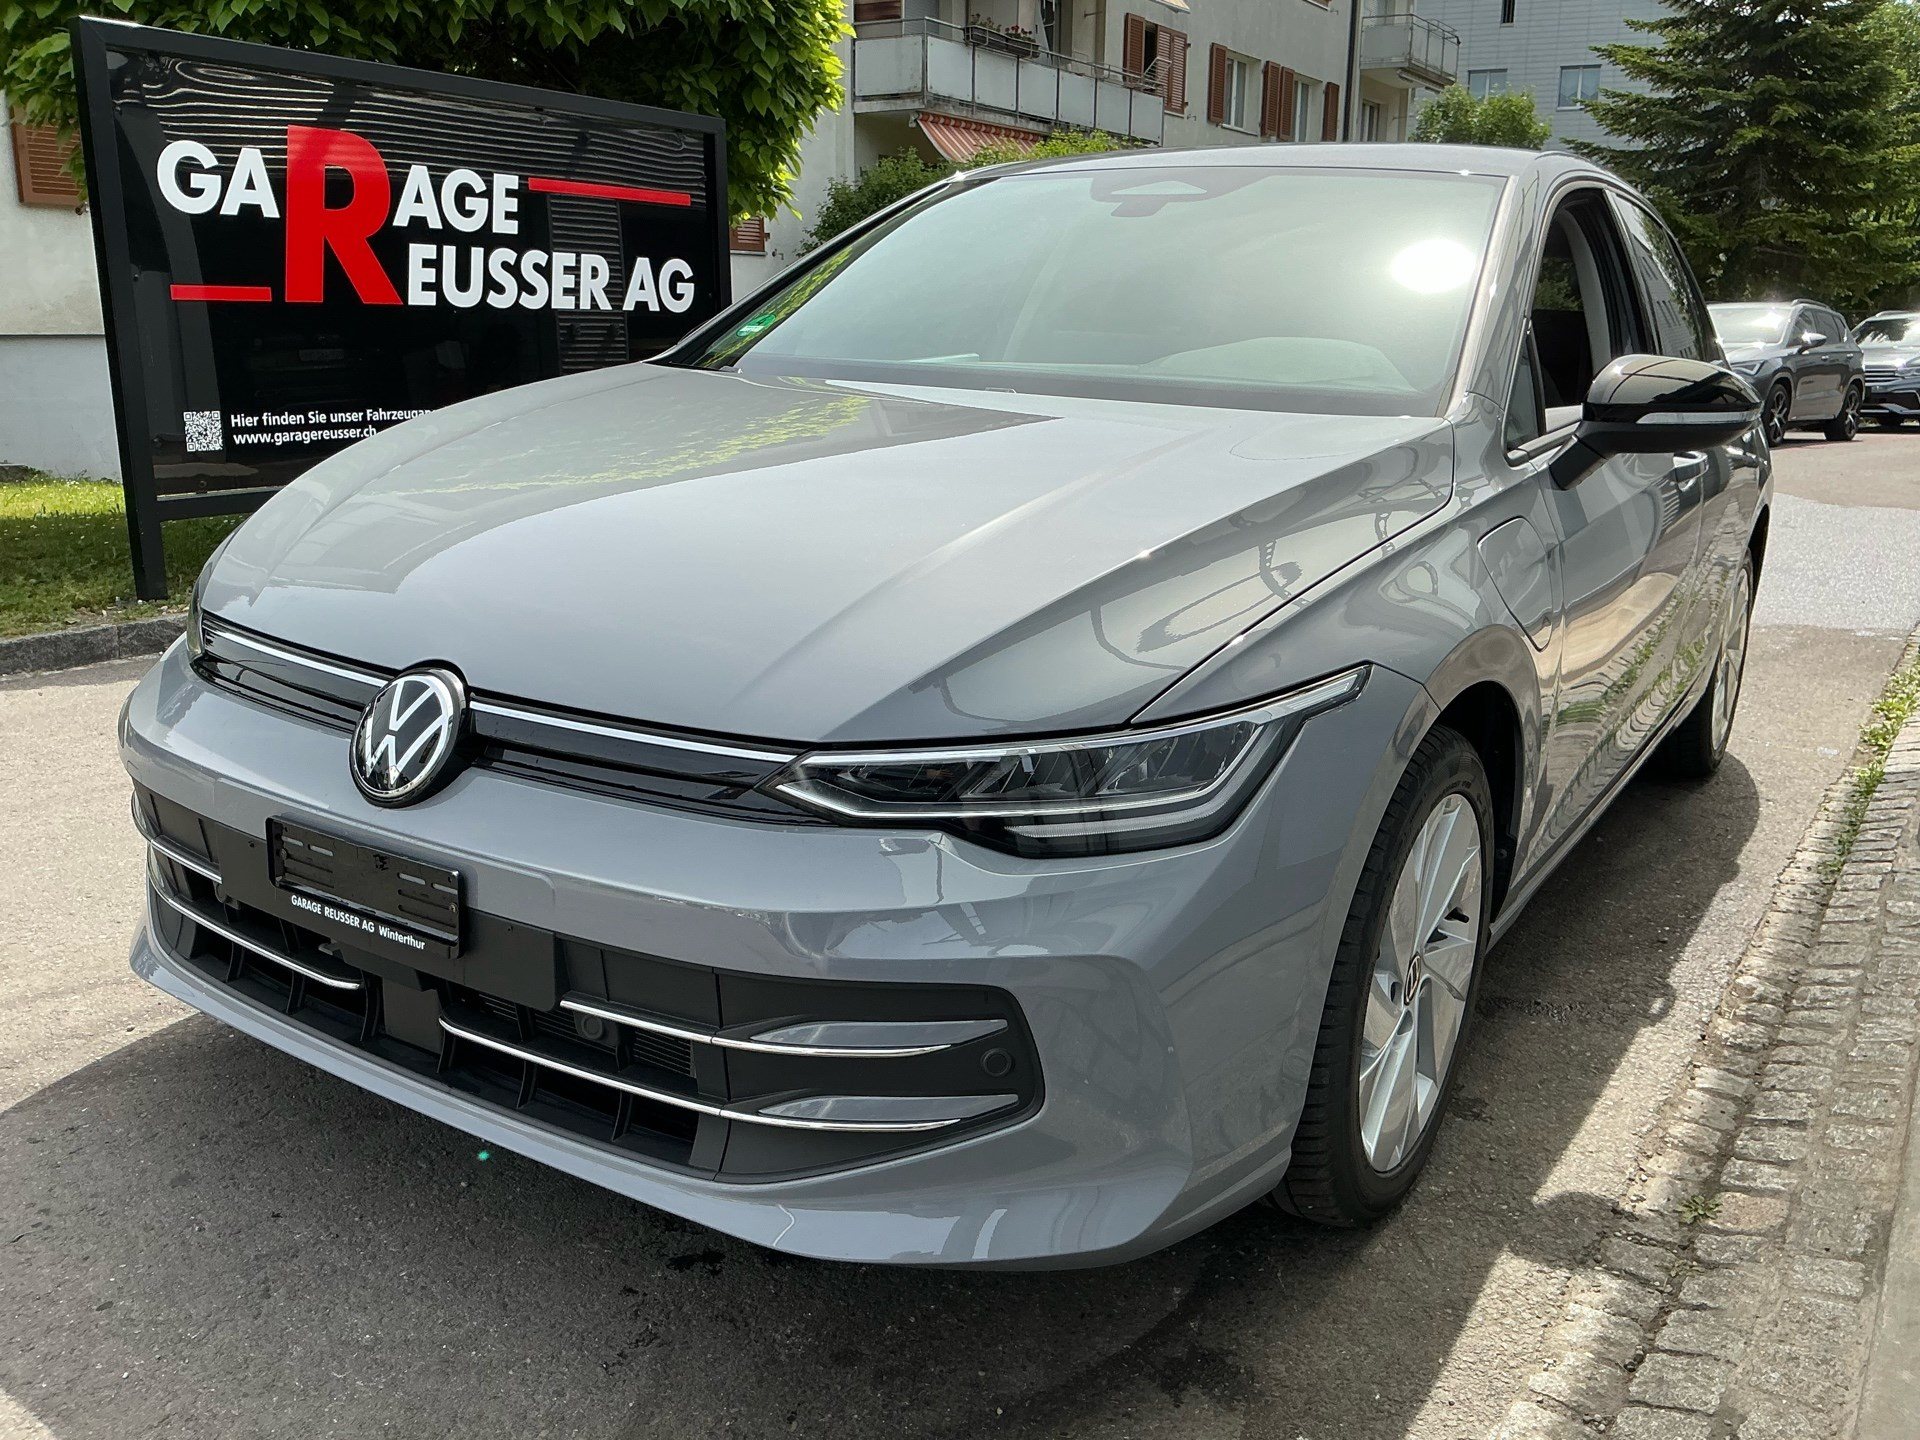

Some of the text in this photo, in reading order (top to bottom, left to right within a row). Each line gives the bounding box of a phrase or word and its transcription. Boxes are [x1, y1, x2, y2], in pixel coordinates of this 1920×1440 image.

[156, 124, 519, 305] GARAGE
[622, 257, 695, 313] AG
[230, 413, 259, 427] Hier
[262, 411, 305, 426] finden
[308, 410, 327, 424] Sie
[329, 412, 364, 423] unser
[232, 424, 377, 446] www.garagereusser.ch
[291, 894, 426, 950] GARAGE REUSSER AG Winterthur
